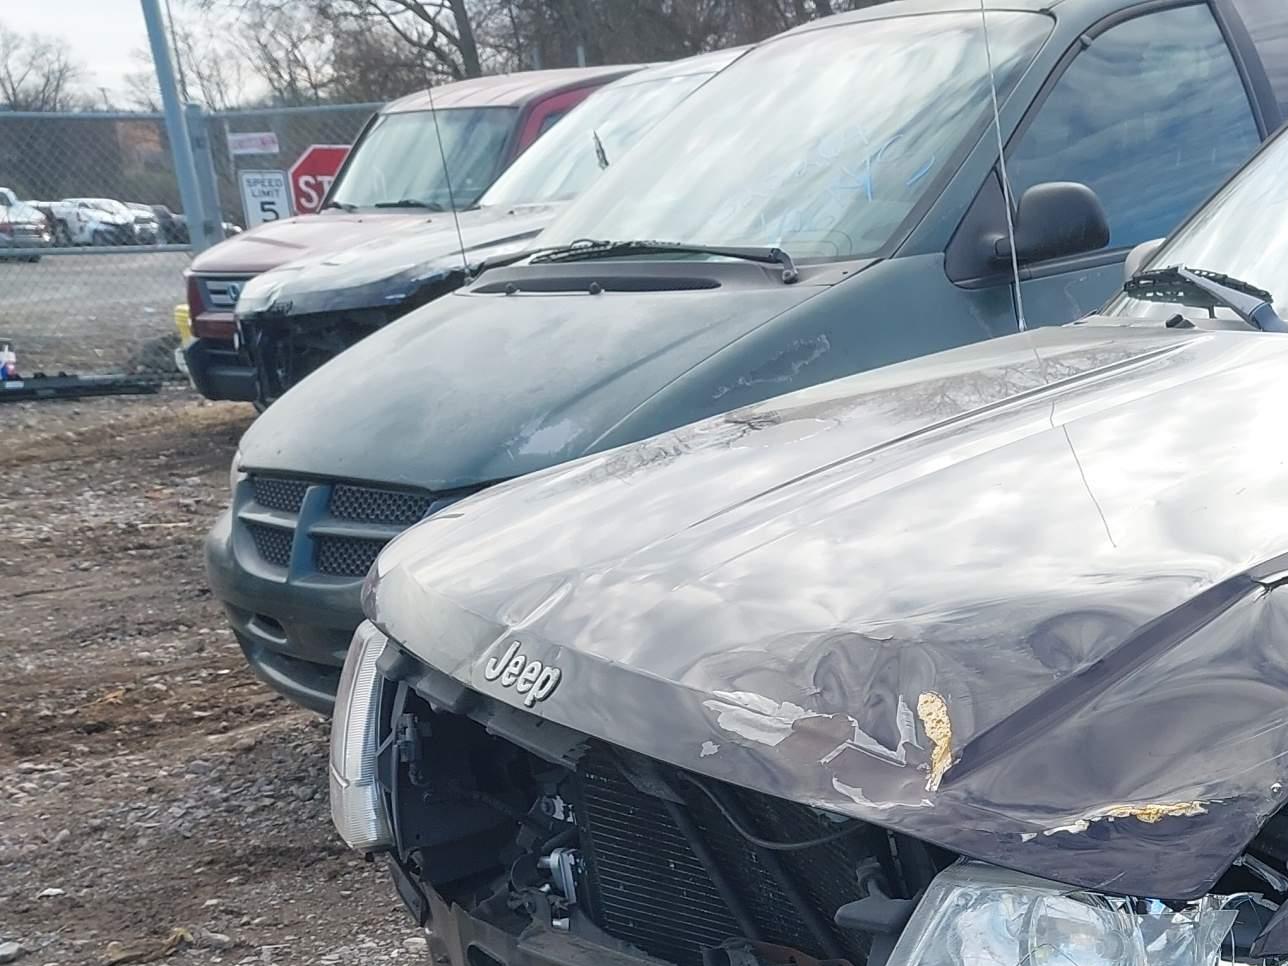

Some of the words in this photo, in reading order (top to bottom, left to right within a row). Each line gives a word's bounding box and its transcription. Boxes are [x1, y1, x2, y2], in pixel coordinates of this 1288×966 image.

[246, 178, 283, 188] SPEED
[251, 188, 281, 198] LIMIT
[299, 175, 334, 208] ST
[260, 202, 280, 222] 5
[486, 640, 561, 708] Jeep
